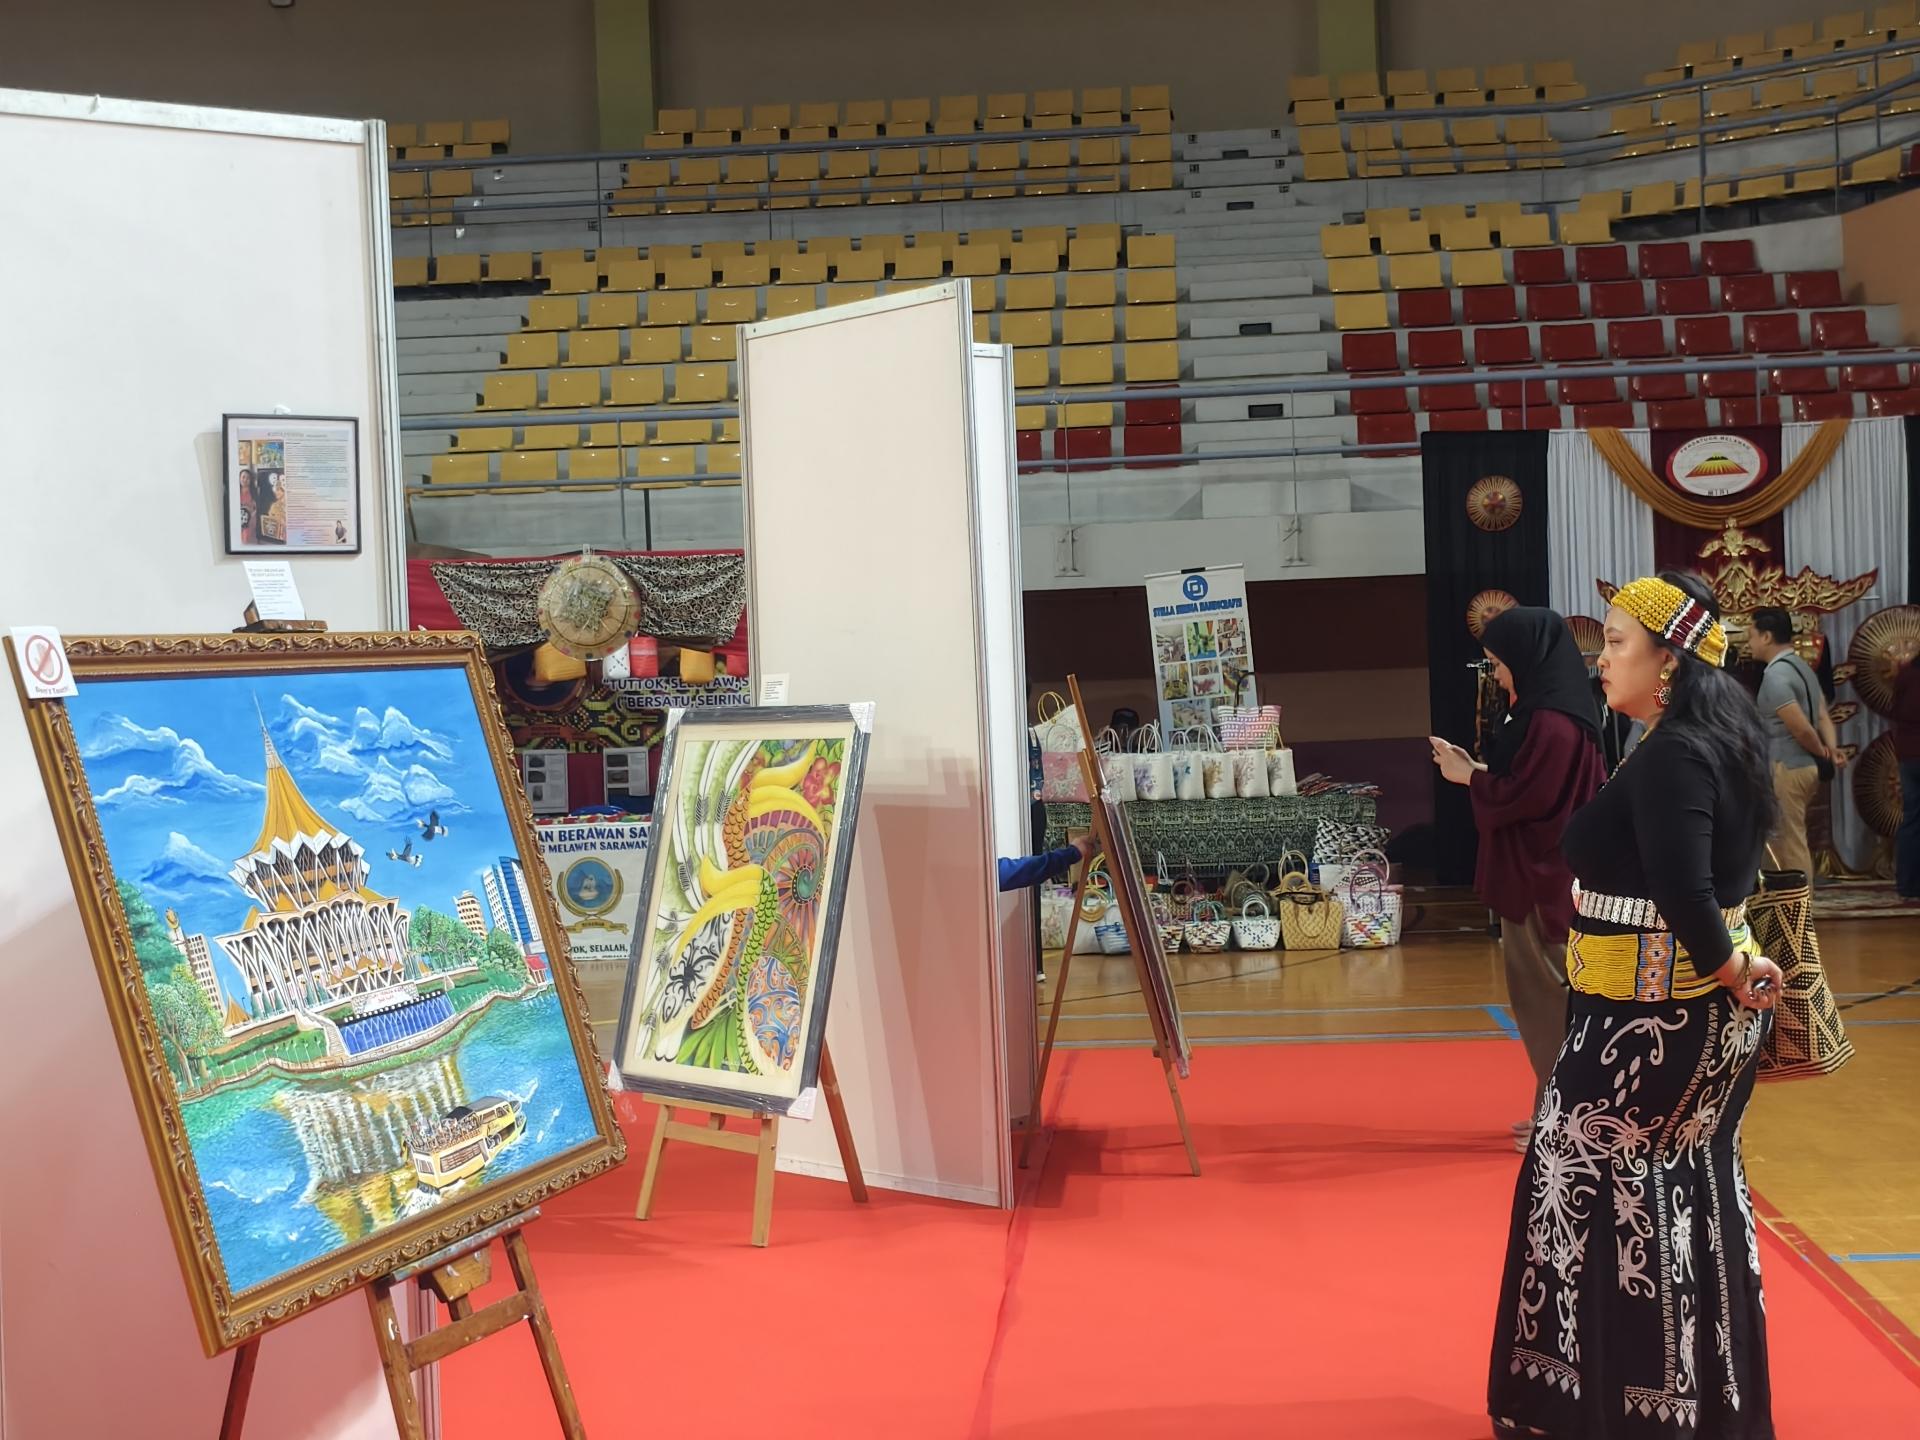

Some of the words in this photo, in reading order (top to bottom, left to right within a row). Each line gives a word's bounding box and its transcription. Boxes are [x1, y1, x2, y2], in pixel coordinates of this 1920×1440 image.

[558, 827, 625, 842] BERAWAN
[548, 841, 597, 853] MELAWEN
[599, 839, 648, 851] SARAWAK
[589, 943, 629, 954] SELALAH,
